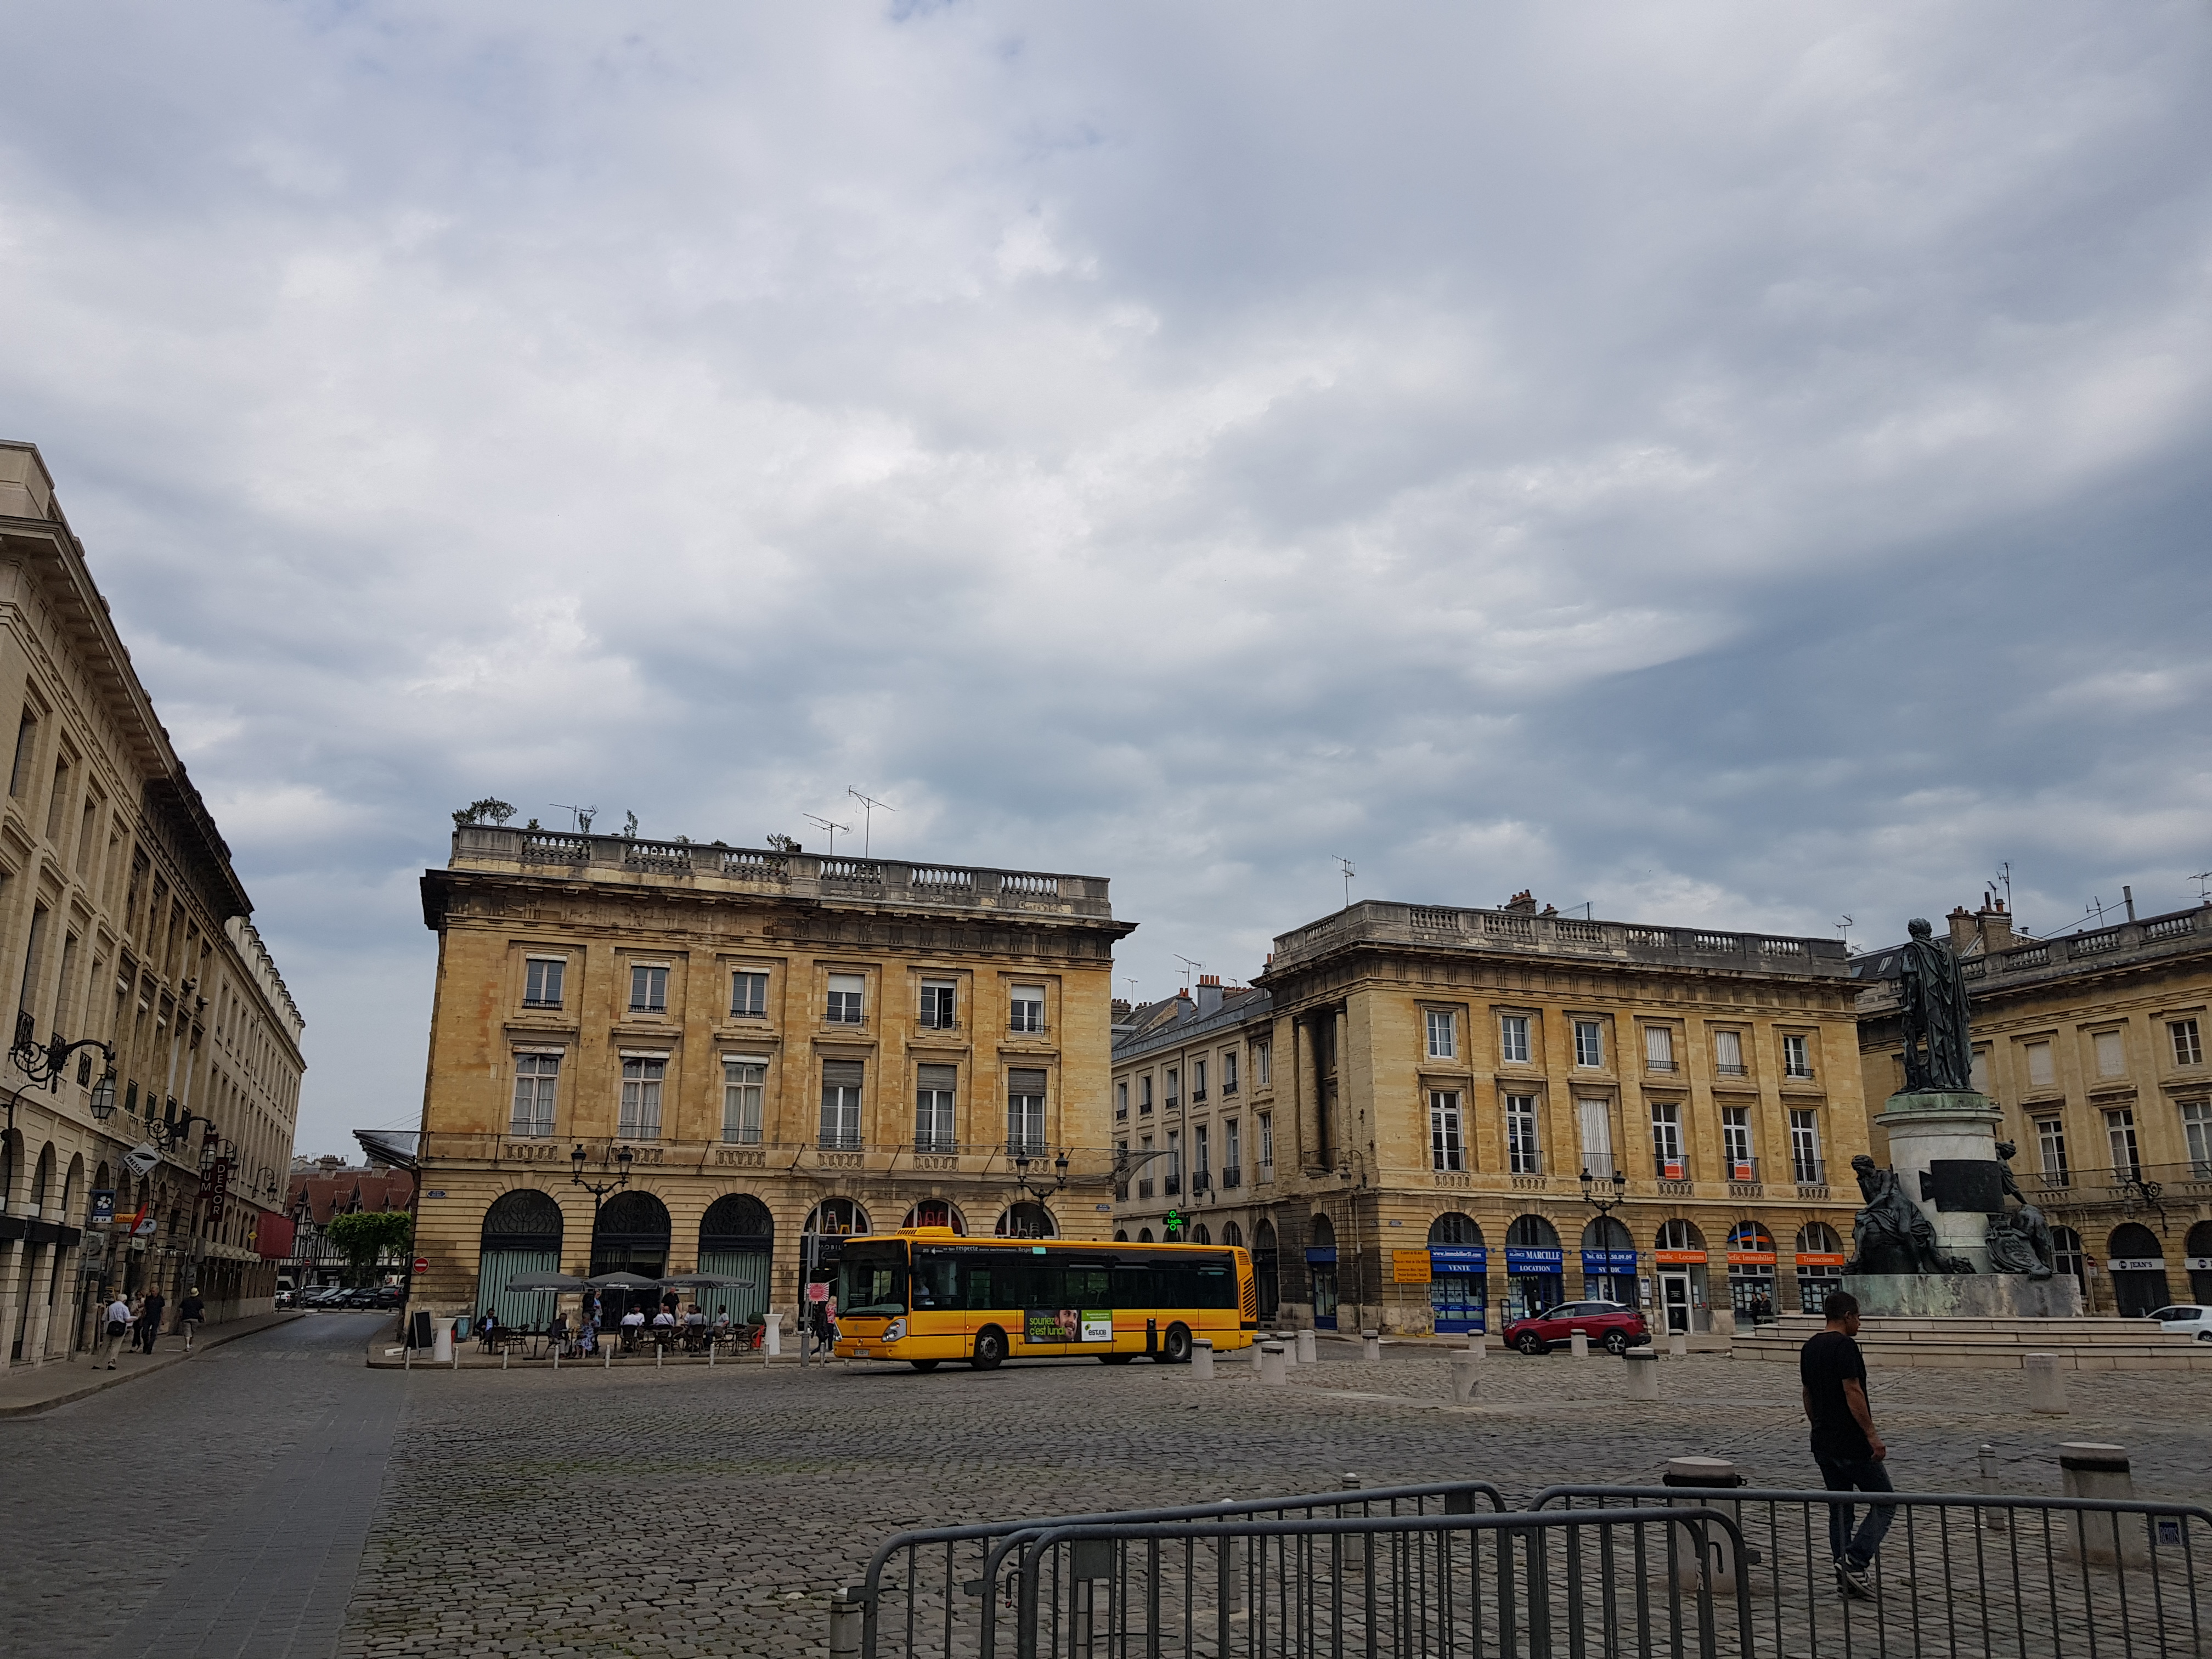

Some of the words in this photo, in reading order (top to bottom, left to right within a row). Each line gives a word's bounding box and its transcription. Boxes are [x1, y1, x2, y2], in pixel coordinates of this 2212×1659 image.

[126, 1156, 144, 1173] PRESSE
[213, 1164, 225, 1214] DECOR
[1526, 1251, 1561, 1260] MARCILLE
[1655, 1252, 1674, 1261] Syndic
[1029, 1316, 1055, 1325] souriez
[1029, 1325, 1046, 1335] c'est
[1047, 1326, 1066, 1335] lundi
